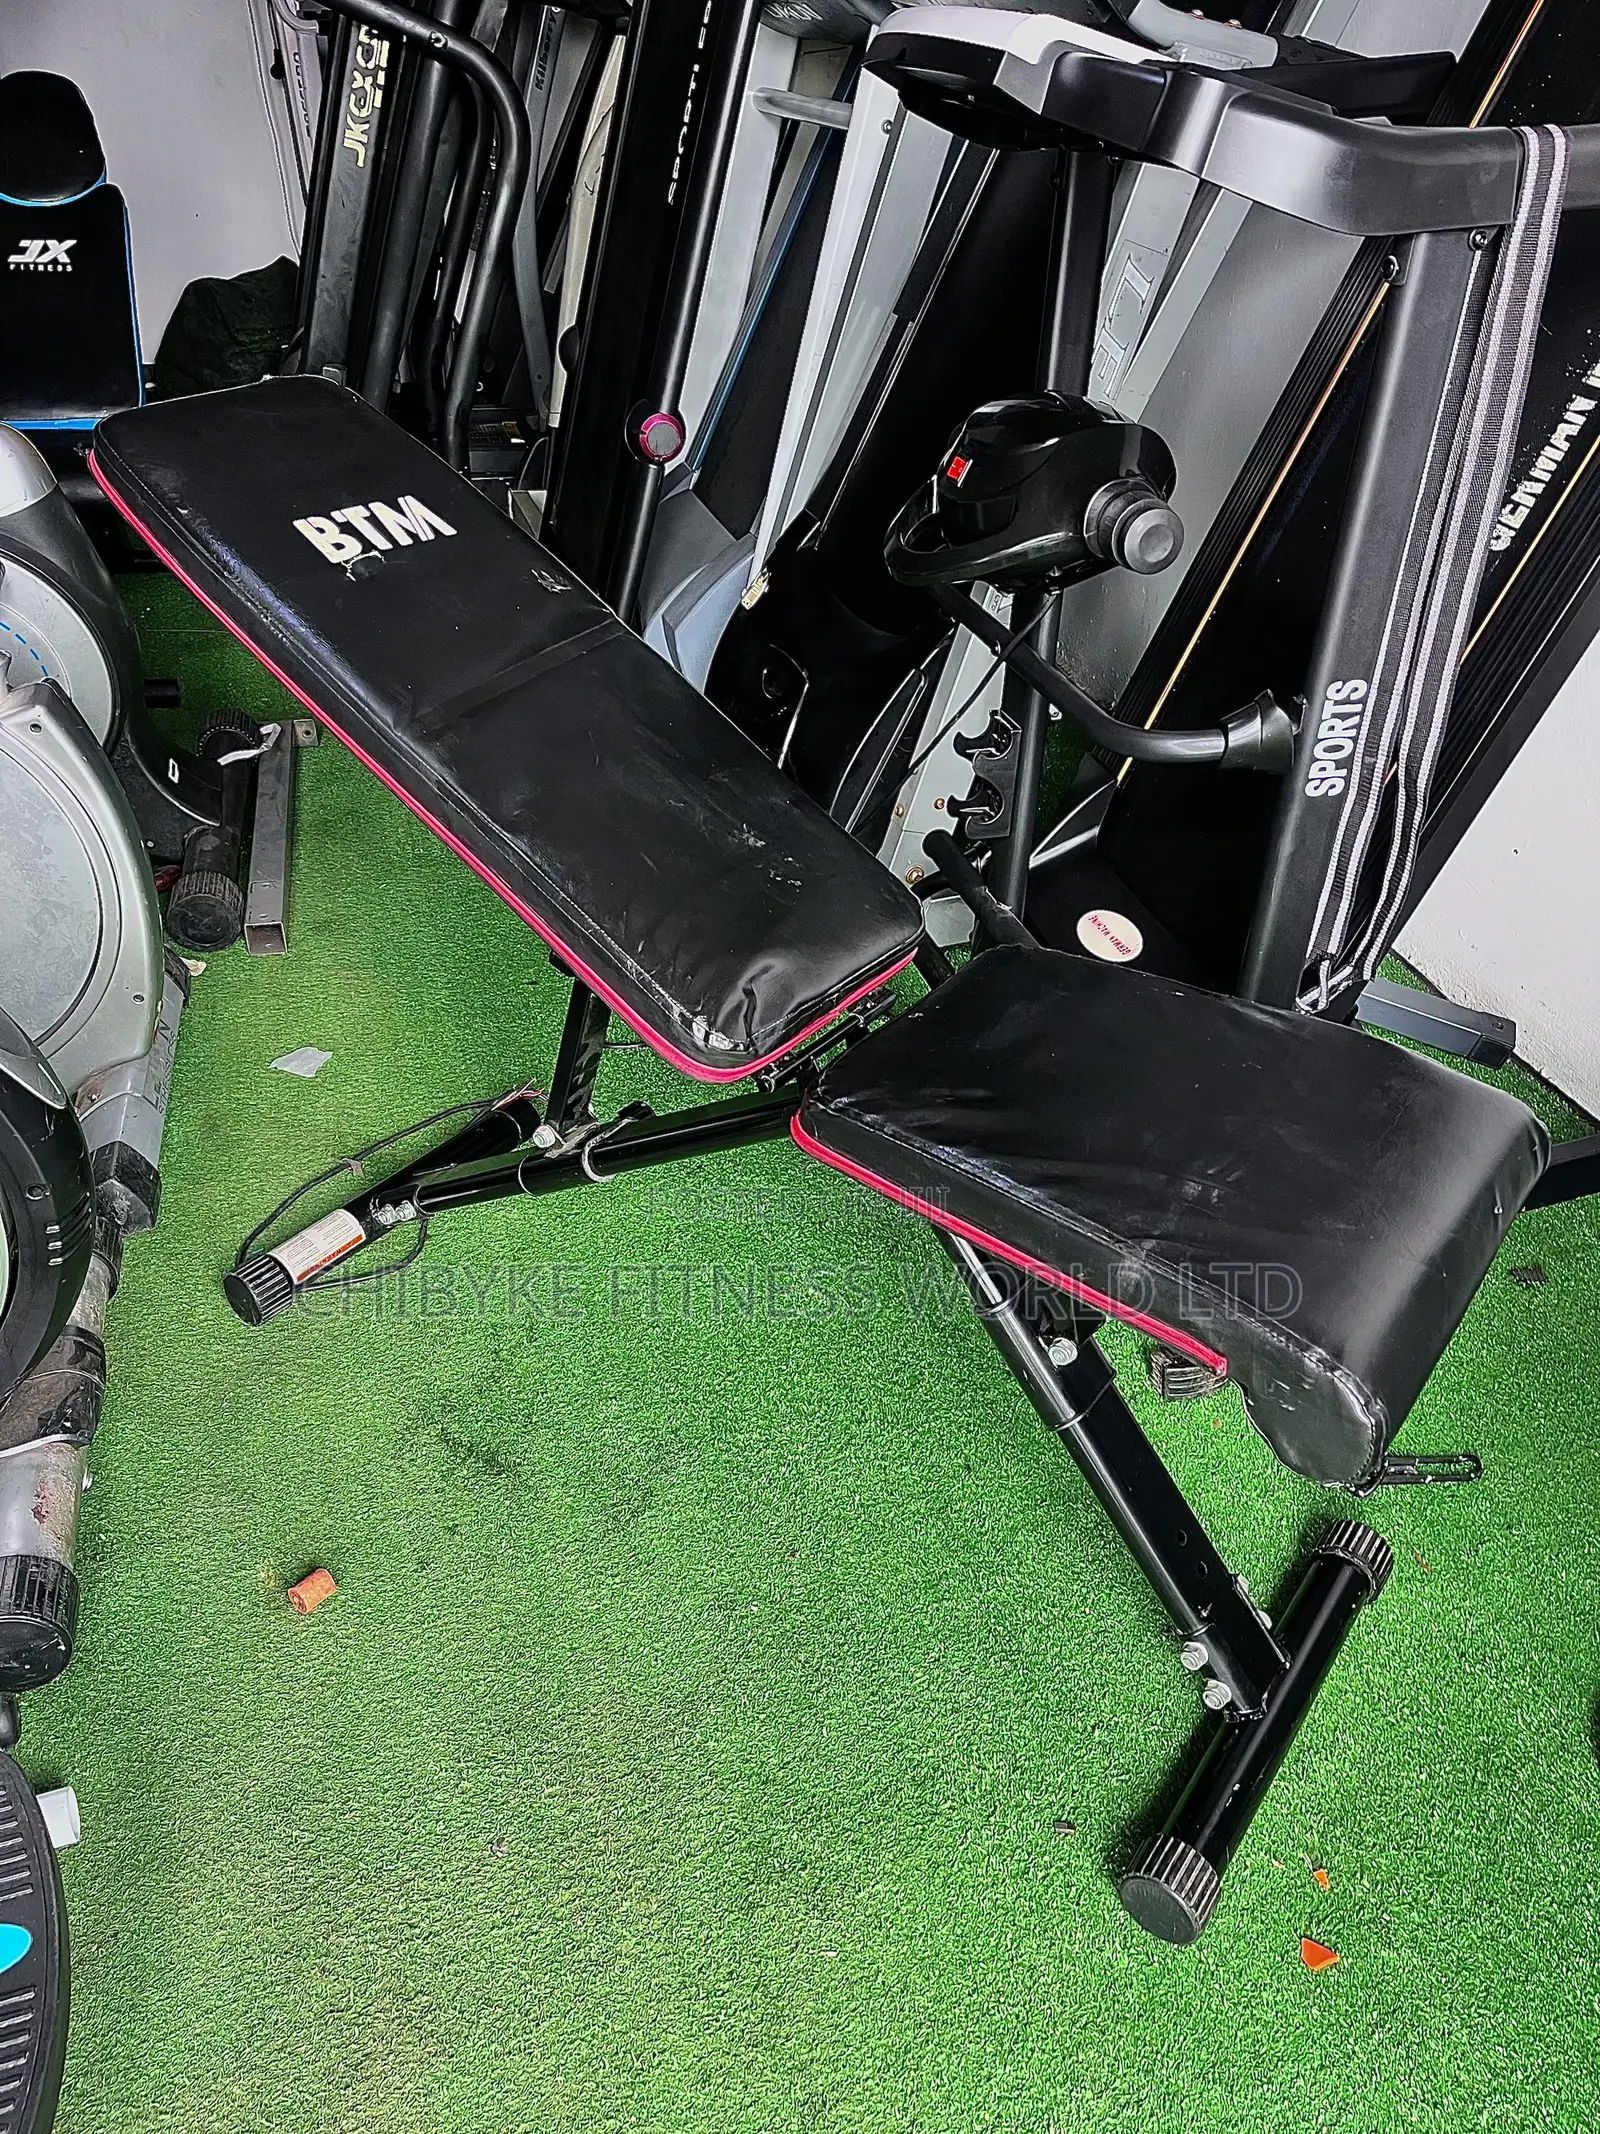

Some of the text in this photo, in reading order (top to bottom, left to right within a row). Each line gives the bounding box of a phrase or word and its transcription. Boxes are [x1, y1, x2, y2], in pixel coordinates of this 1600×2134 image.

[7, 239, 78, 263] JX
[9, 264, 73, 273] FITNESS
[292, 495, 458, 563] BTM
[1304, 679, 1368, 797] SPORTS
